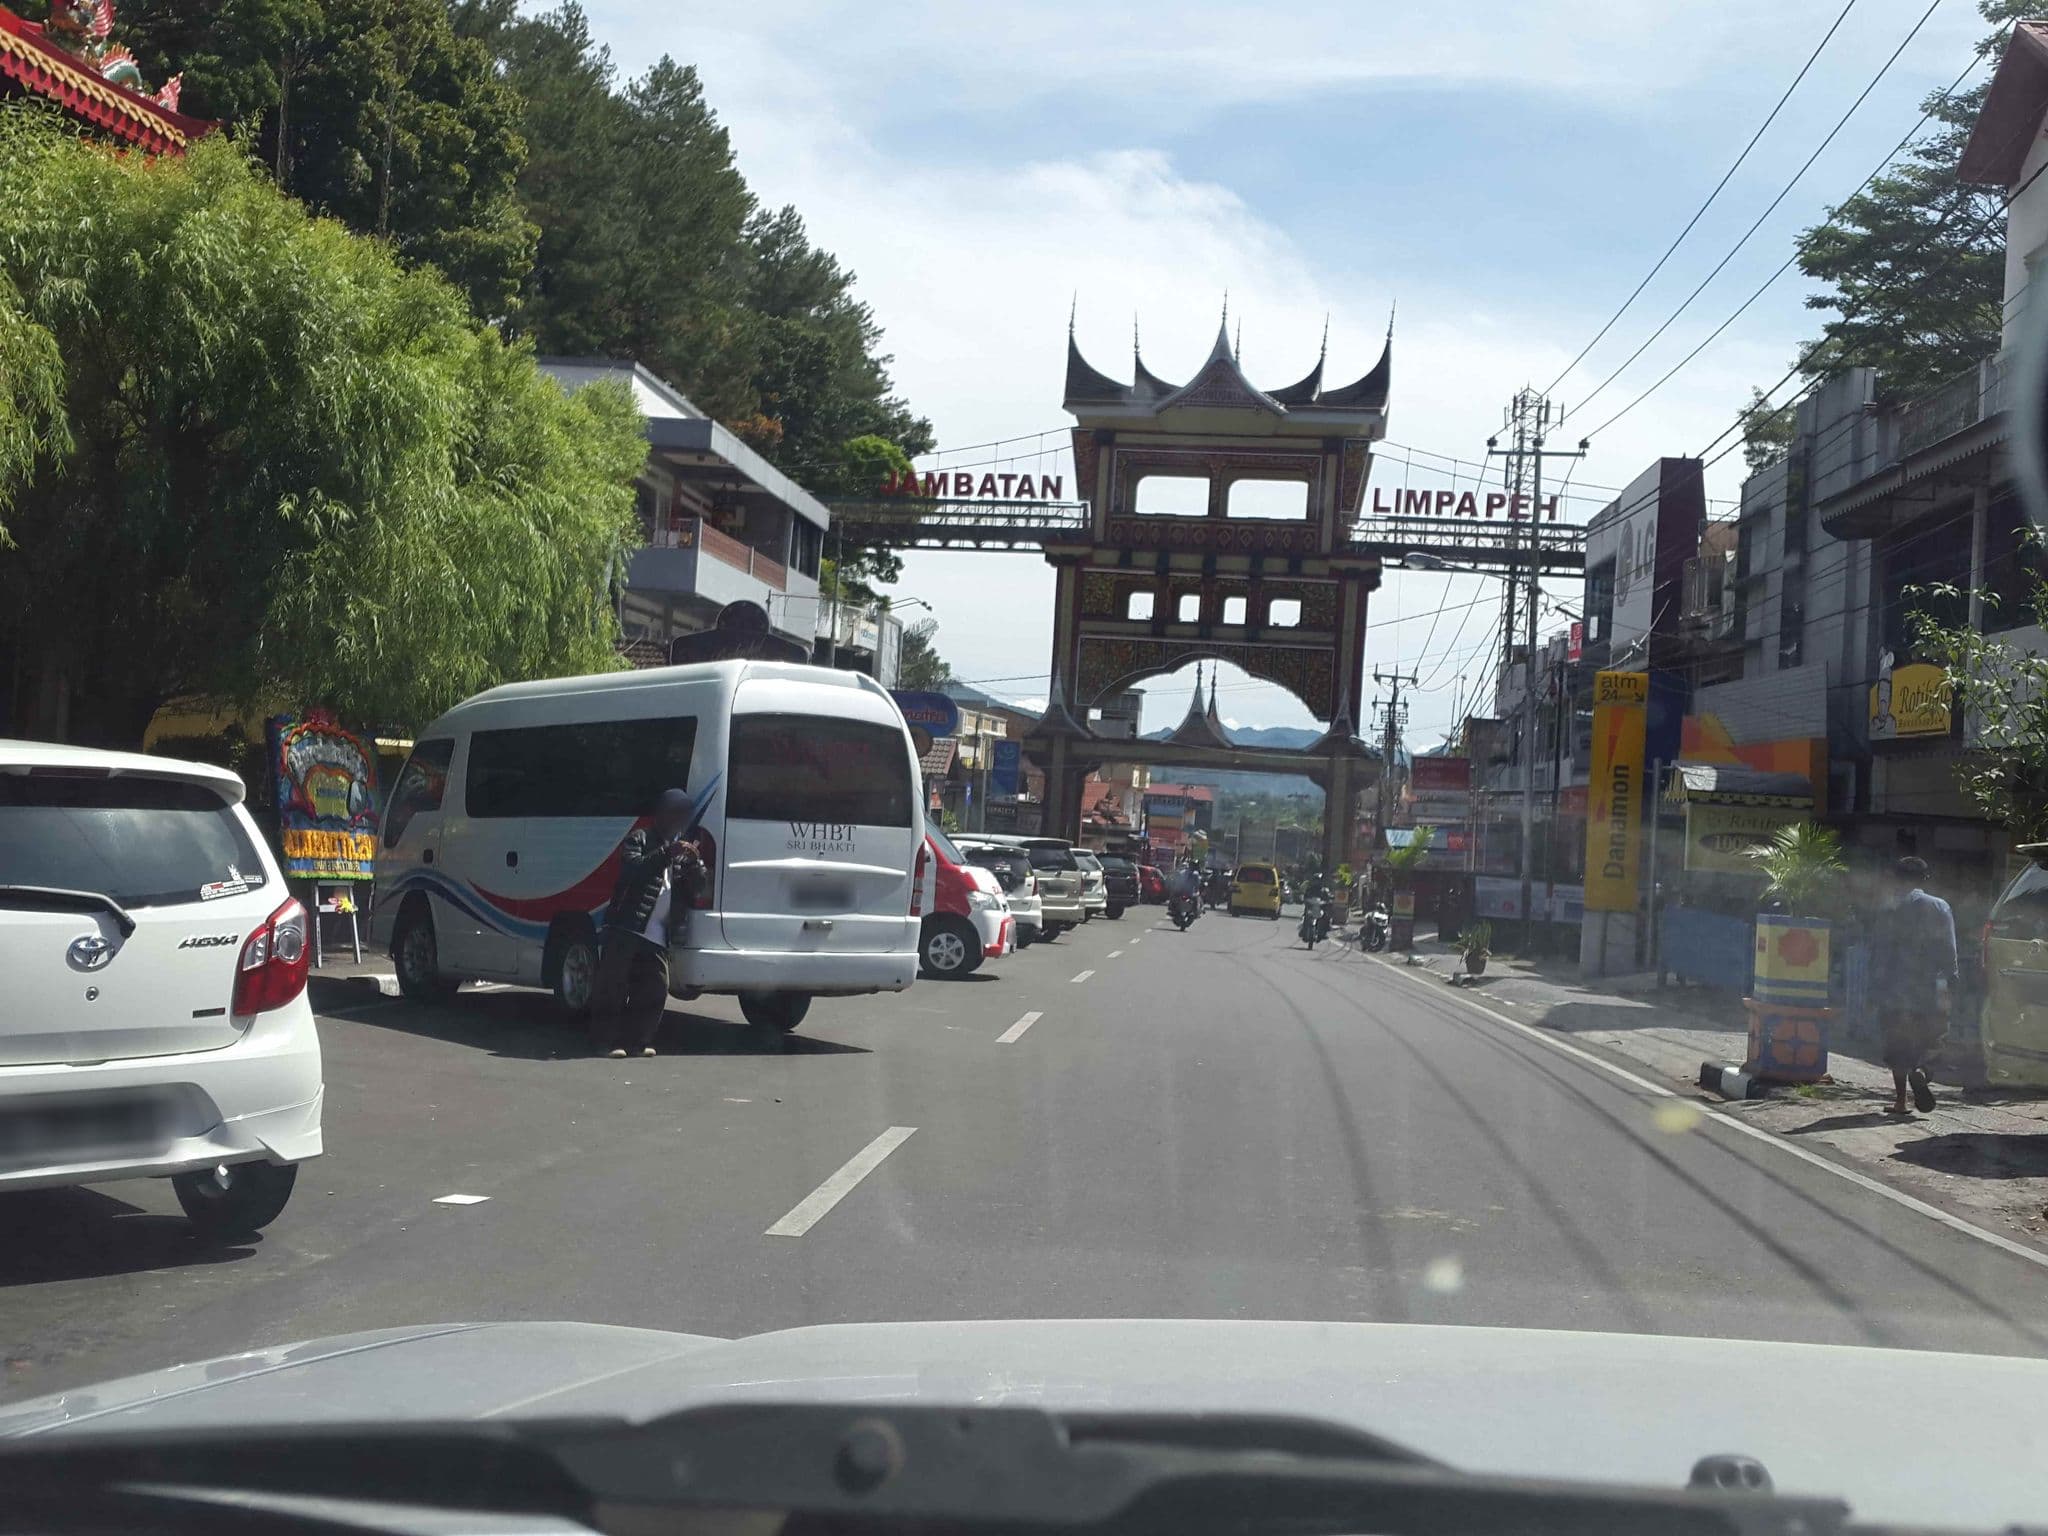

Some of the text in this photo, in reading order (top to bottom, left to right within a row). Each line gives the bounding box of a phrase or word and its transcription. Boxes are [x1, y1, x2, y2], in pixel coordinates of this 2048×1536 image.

[880, 471, 1063, 499] JAMBATAN
[1372, 487, 1560, 521] LIMPAPEH
[1601, 673, 1638, 689] atm
[788, 821, 857, 842] WHBT
[1602, 765, 1630, 879] Danamon
[787, 840, 855, 853] SRI BHAKTI
[178, 934, 239, 949] AGYA
